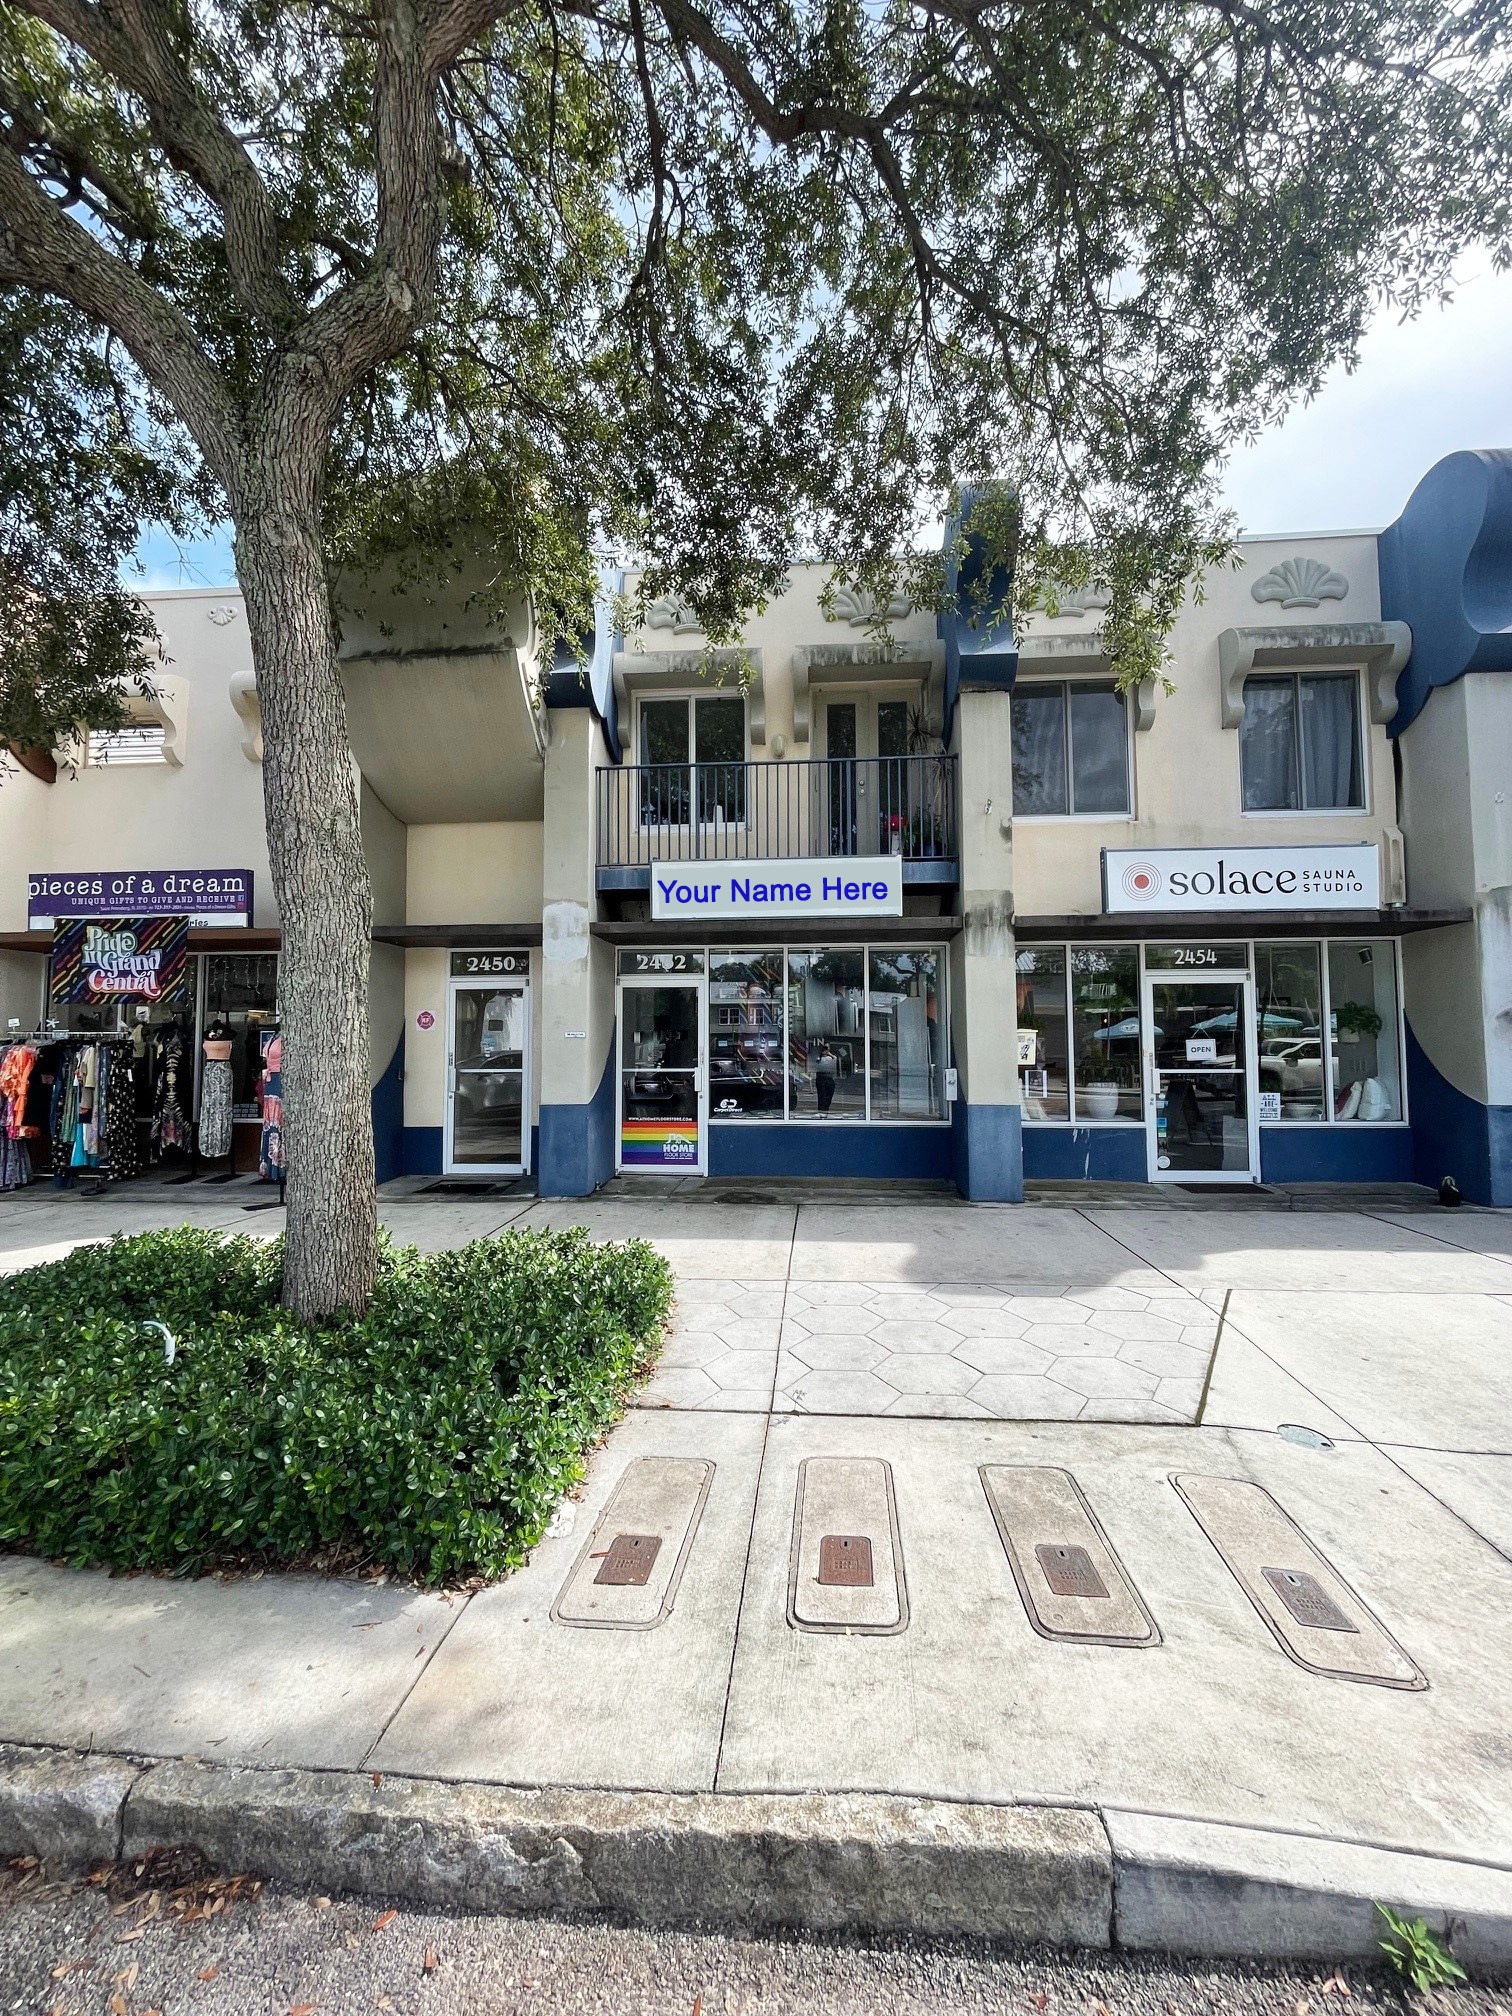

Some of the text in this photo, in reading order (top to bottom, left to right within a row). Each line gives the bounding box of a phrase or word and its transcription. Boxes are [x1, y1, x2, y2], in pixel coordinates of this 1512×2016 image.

[1169, 860, 1297, 895] solace
[1303, 870, 1355, 879] SAUNA
[29, 875, 244, 899] pieces of a dream
[657, 877, 888, 903] Your Name Here
[1303, 882, 1363, 892] STUDIO
[138, 896, 148, 904] TO
[176, 895, 193, 903] AND
[197, 895, 235, 903] RECEIVE
[83, 927, 137, 957] Pride
[98, 949, 161, 978] Grand
[466, 956, 516, 971] 2450
[1174, 949, 1217, 965] 2454
[88, 968, 161, 997] Central
[663, 1144, 695, 1152] HOME
